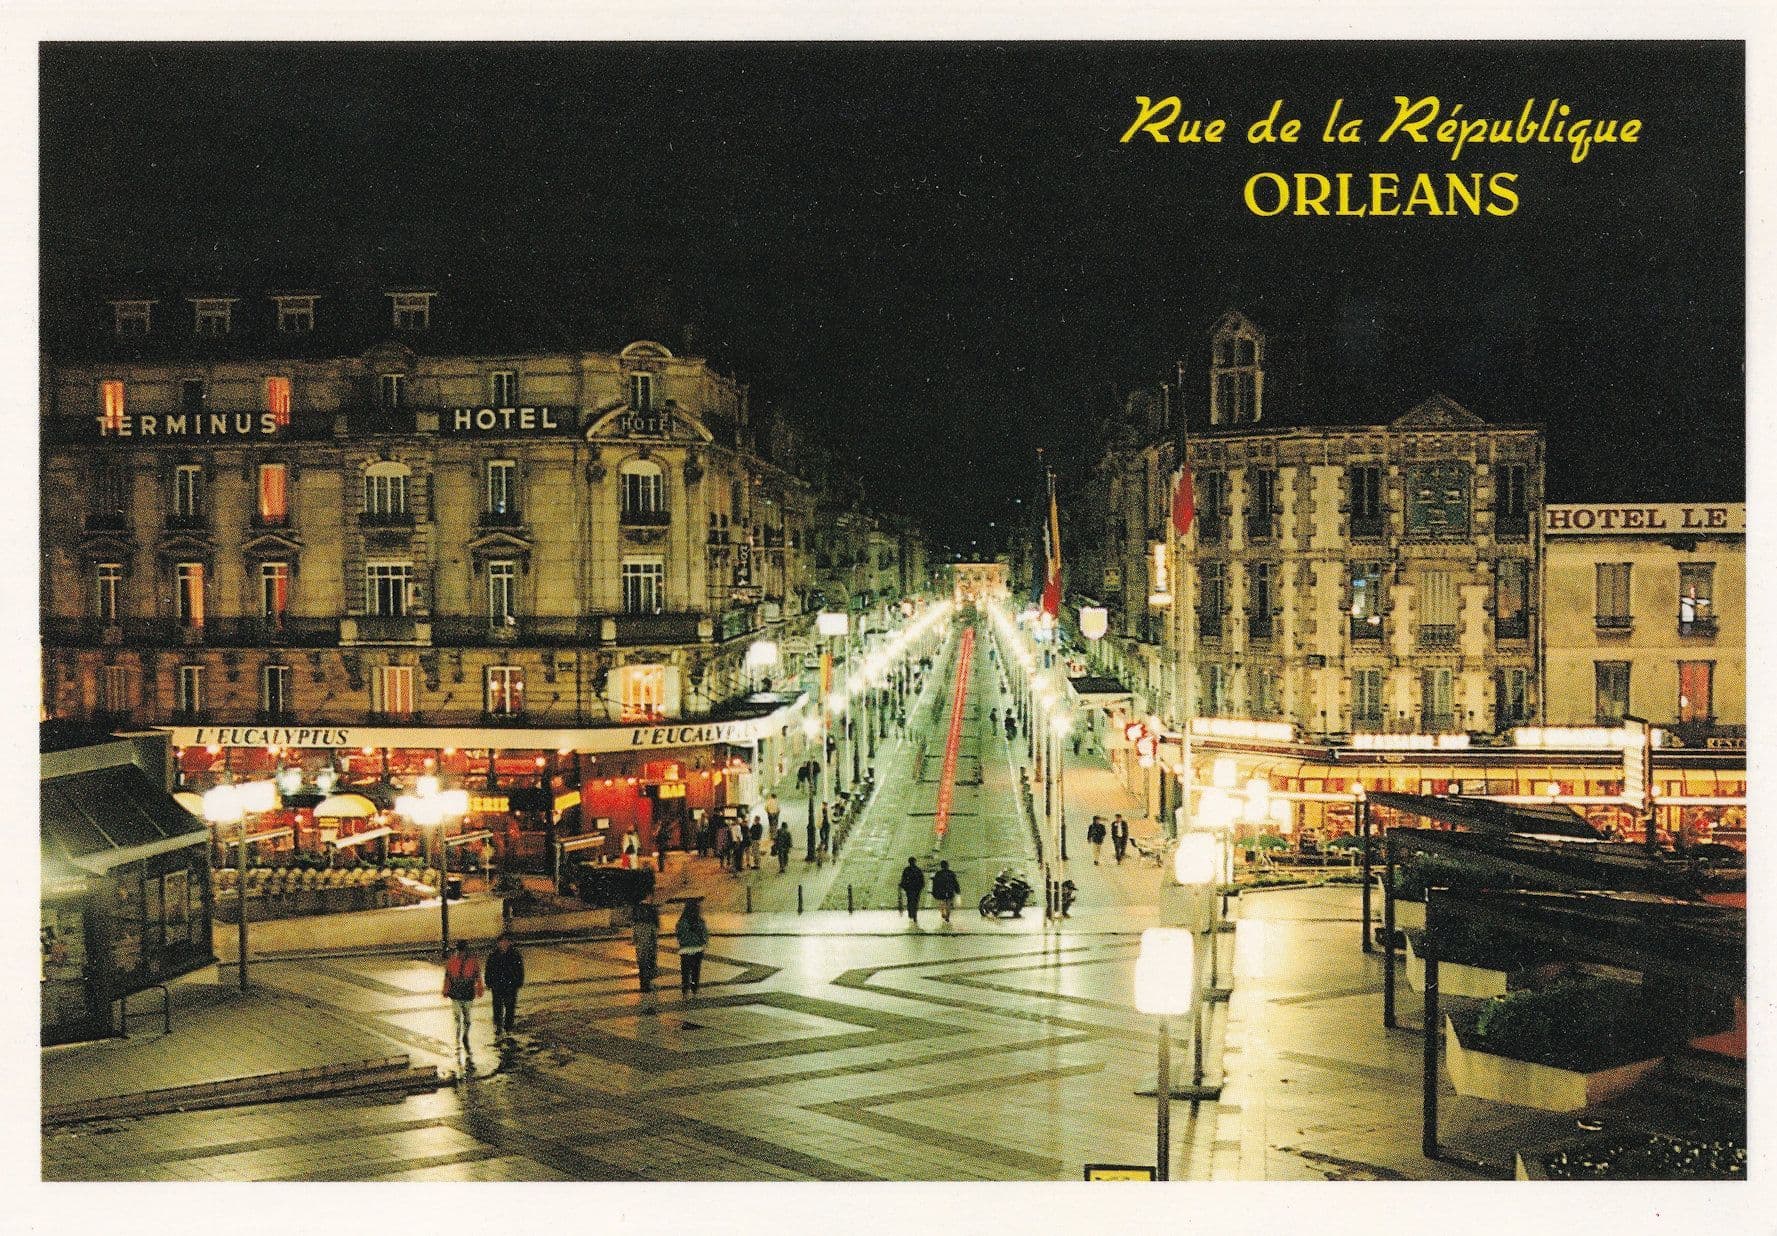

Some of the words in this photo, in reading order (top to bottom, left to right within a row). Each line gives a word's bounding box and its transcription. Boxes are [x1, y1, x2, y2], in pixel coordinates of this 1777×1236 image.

[96, 413, 277, 436] TERMINUS
[455, 407, 558, 430] HOTEL
[1547, 508, 1667, 530] HOTEL
[1681, 508, 1728, 529] LE
[195, 728, 349, 746] L'EUCALYPTUS
[631, 723, 759, 746] L'EUCALYP
